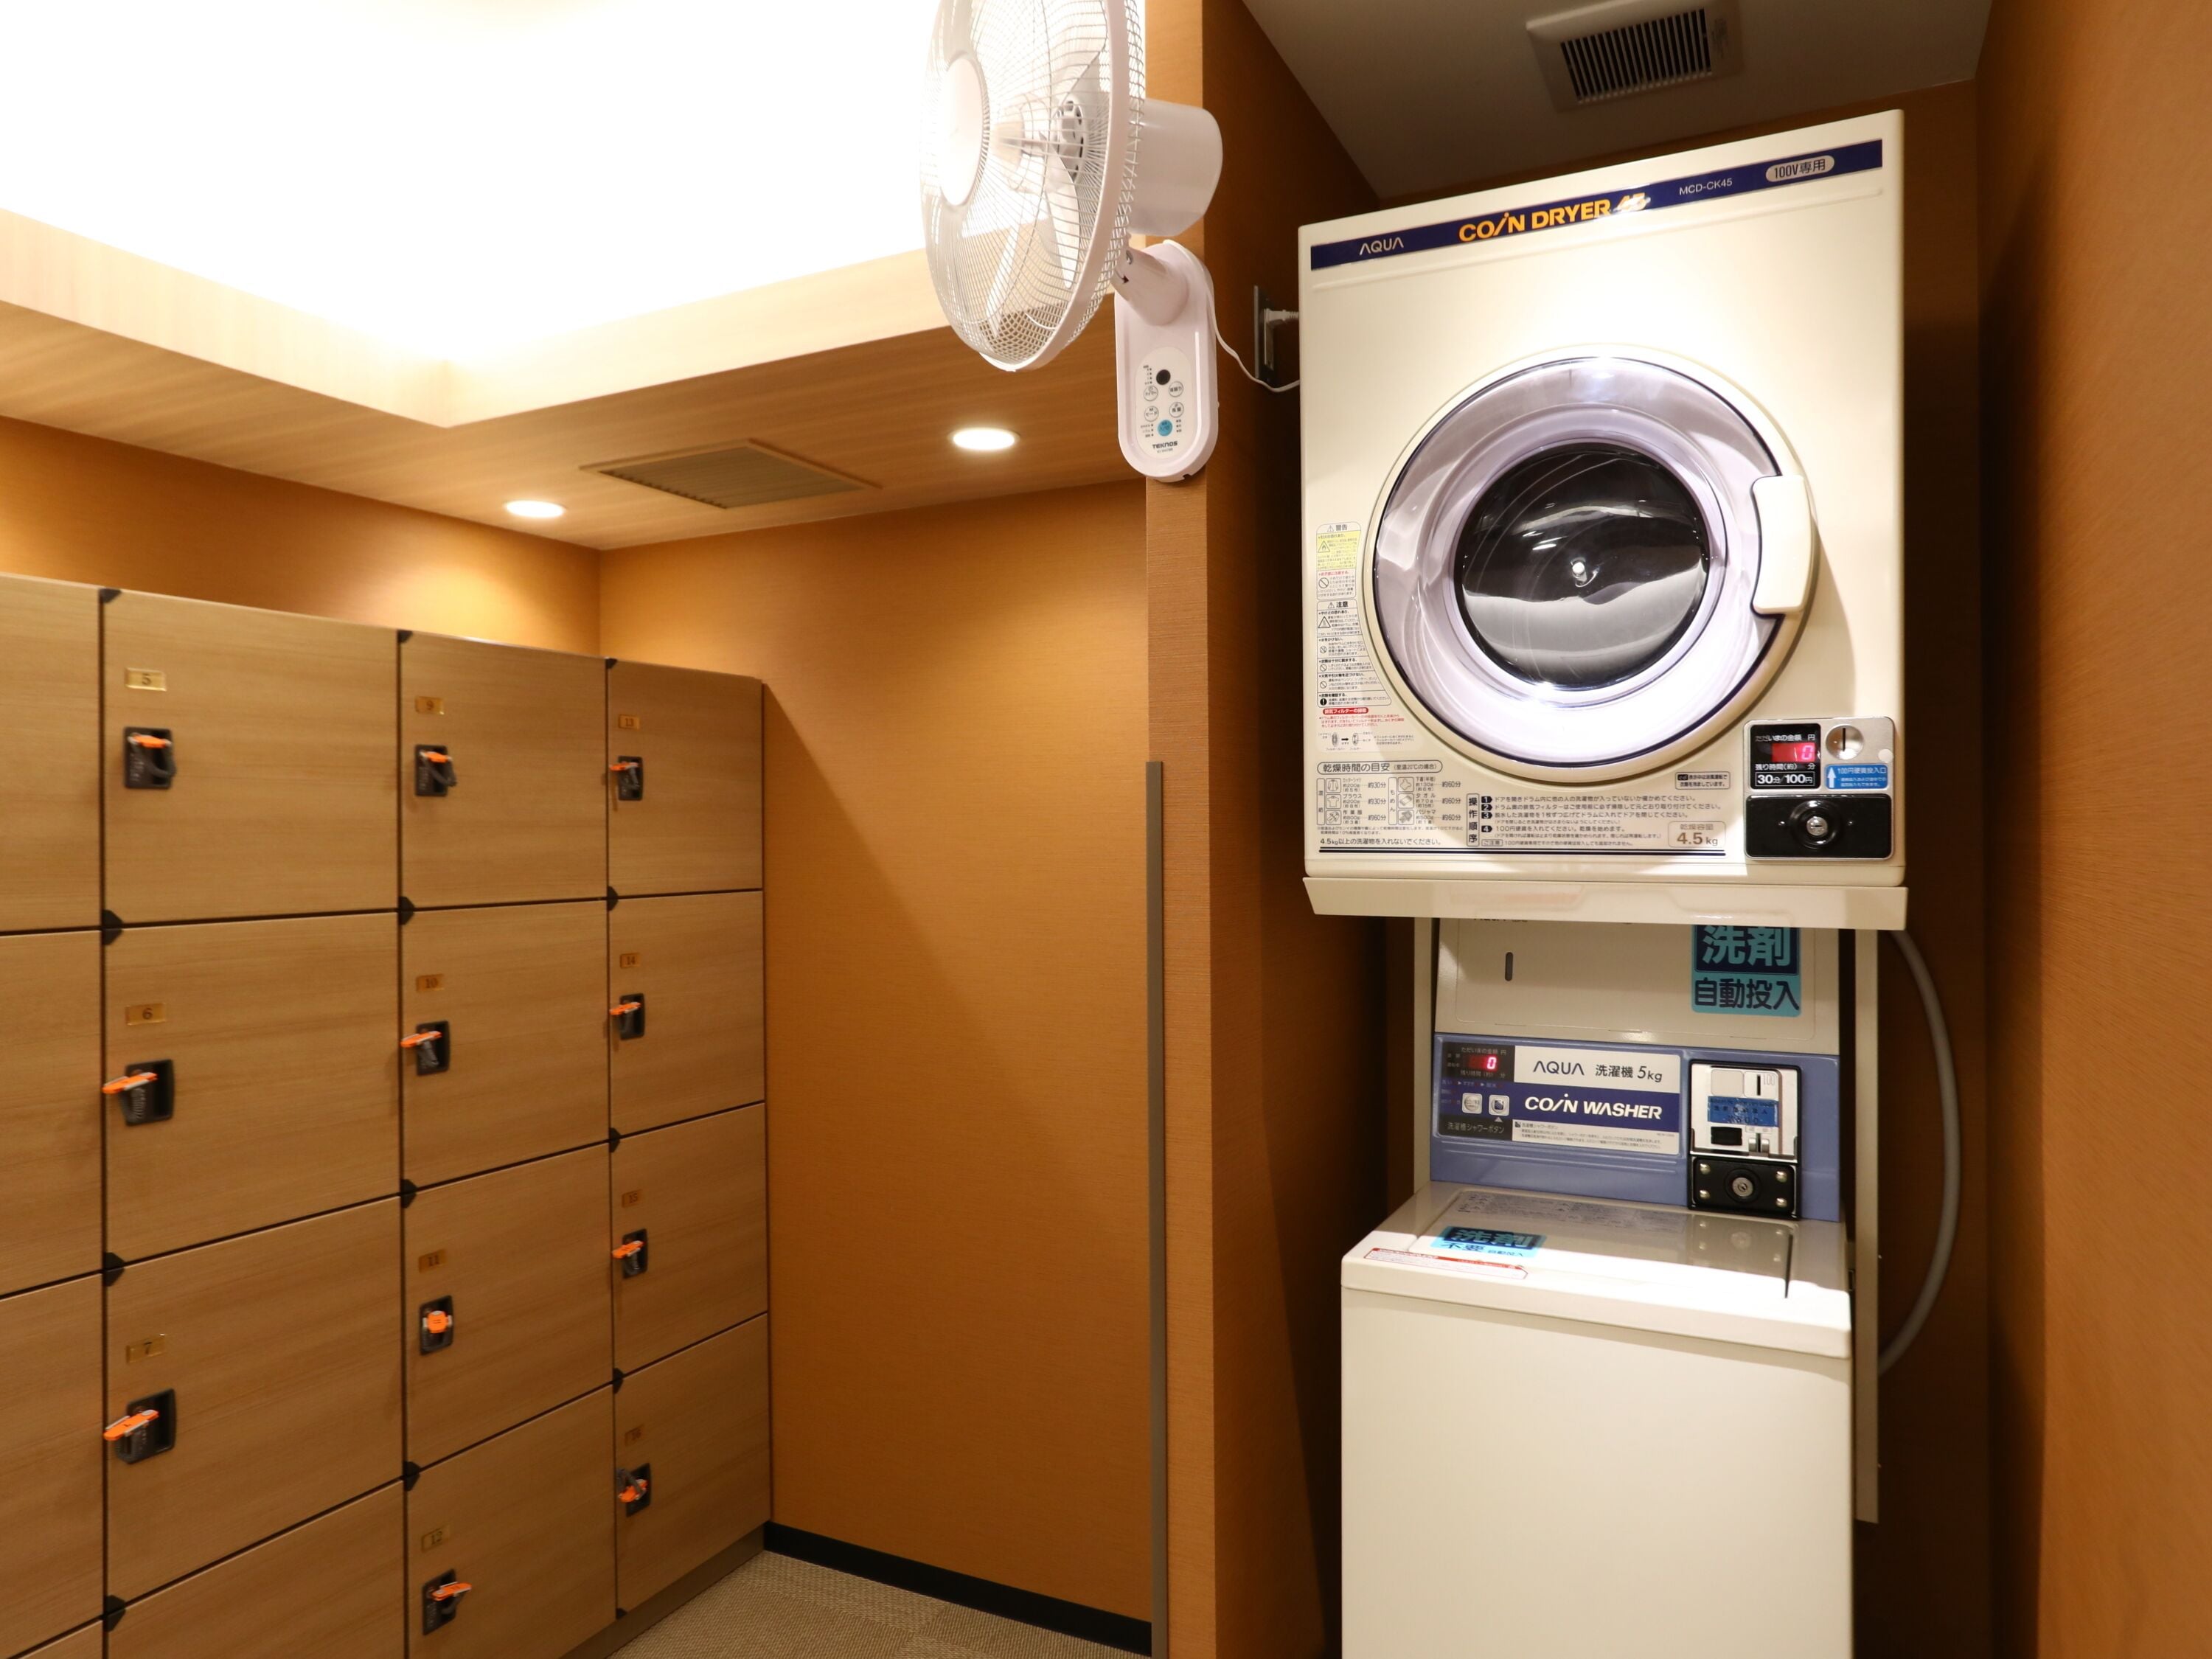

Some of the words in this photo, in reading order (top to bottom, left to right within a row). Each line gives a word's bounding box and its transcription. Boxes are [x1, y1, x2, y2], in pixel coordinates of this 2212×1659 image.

[1773, 159, 1826, 179] 100V専用
[1678, 178, 1733, 196] MCD-CK45
[1458, 212, 1526, 243] COIN
[1531, 199, 1612, 230] DRYER
[1359, 237, 1405, 256] AQUA
[1152, 440, 1178, 449] TEKNOS
[142, 672, 152, 686] 5
[1808, 734, 1816, 742] 円
[1801, 745, 1815, 760] 0
[1323, 762, 1390, 773] 乾燥時間の目安
[1468, 797, 1478, 843] 操作順序
[1677, 832, 1703, 844] 4.5
[1705, 837, 1718, 846] kg
[1702, 925, 1791, 967] 洗剤
[1695, 977, 1800, 1011] 自動投入
[142, 1007, 153, 1020] 6
[1486, 1057, 1497, 1070] 0
[1532, 1060, 1585, 1076] AQUA
[1595, 1064, 1634, 1079] 洗濯機
[1636, 1065, 1663, 1082] 5kg
[1524, 1093, 1579, 1113] COIN
[1583, 1100, 1663, 1120] WASHER
[1450, 1229, 1534, 1248] 洗剤
[1440, 1241, 1484, 1253] 不要
[143, 1340, 153, 1355] 7
